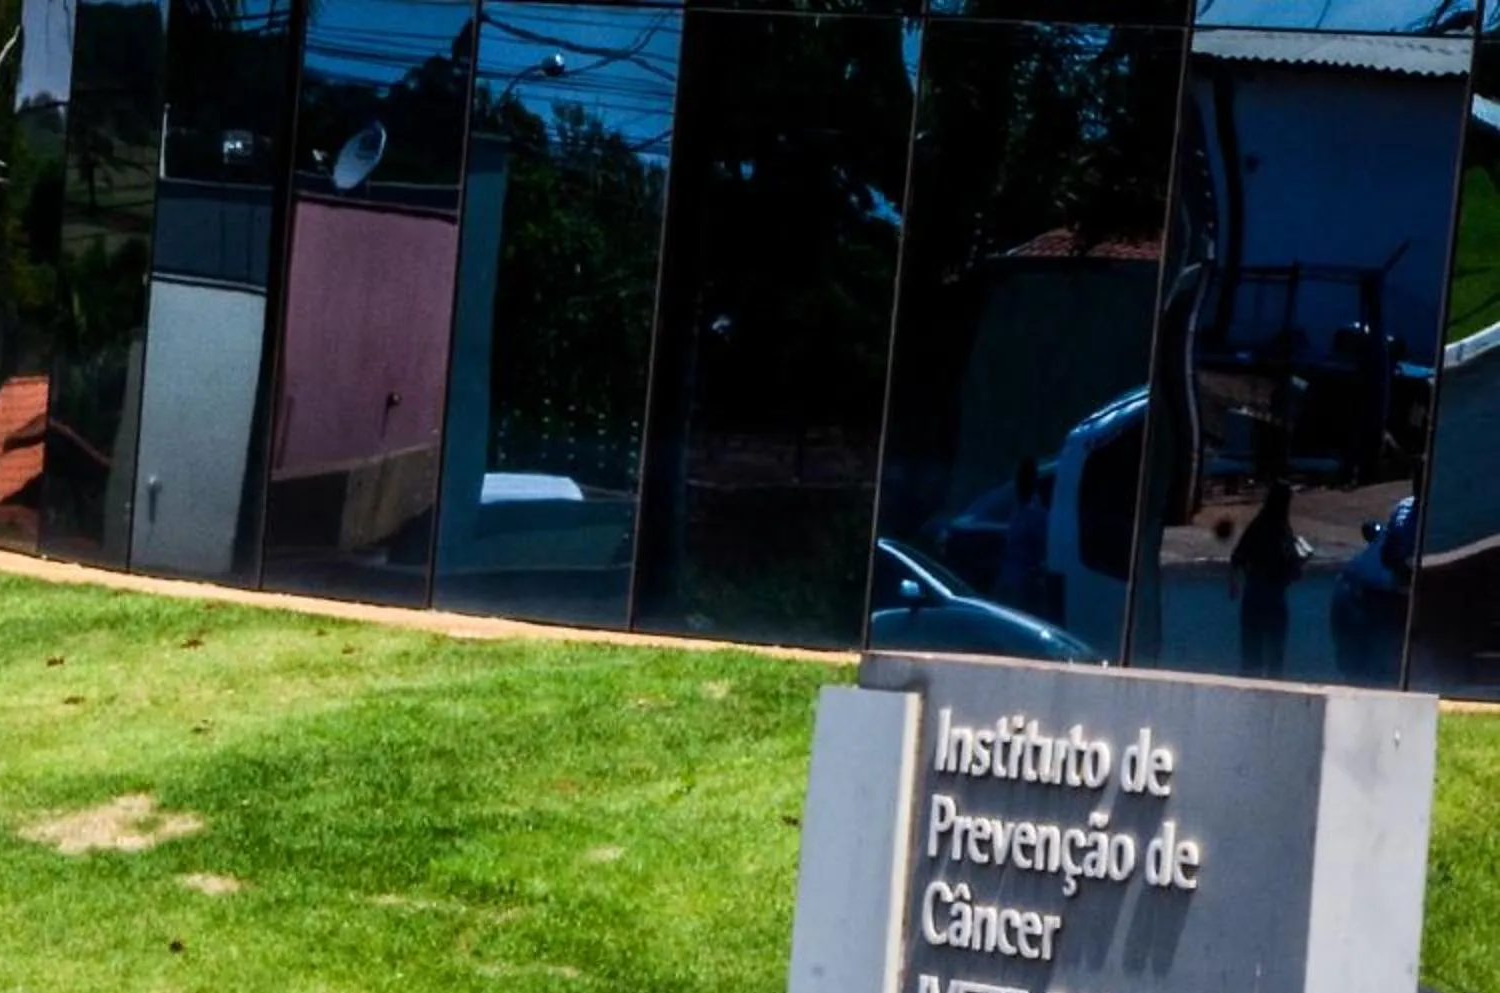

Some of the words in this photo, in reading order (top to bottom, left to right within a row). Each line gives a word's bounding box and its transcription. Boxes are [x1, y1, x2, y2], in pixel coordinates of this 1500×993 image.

[934, 707, 1111, 789] Instituto
[1120, 727, 1175, 797] de
[927, 794, 1135, 896] Prevenção
[1145, 821, 1202, 889] de
[921, 880, 1062, 961] Câncer
